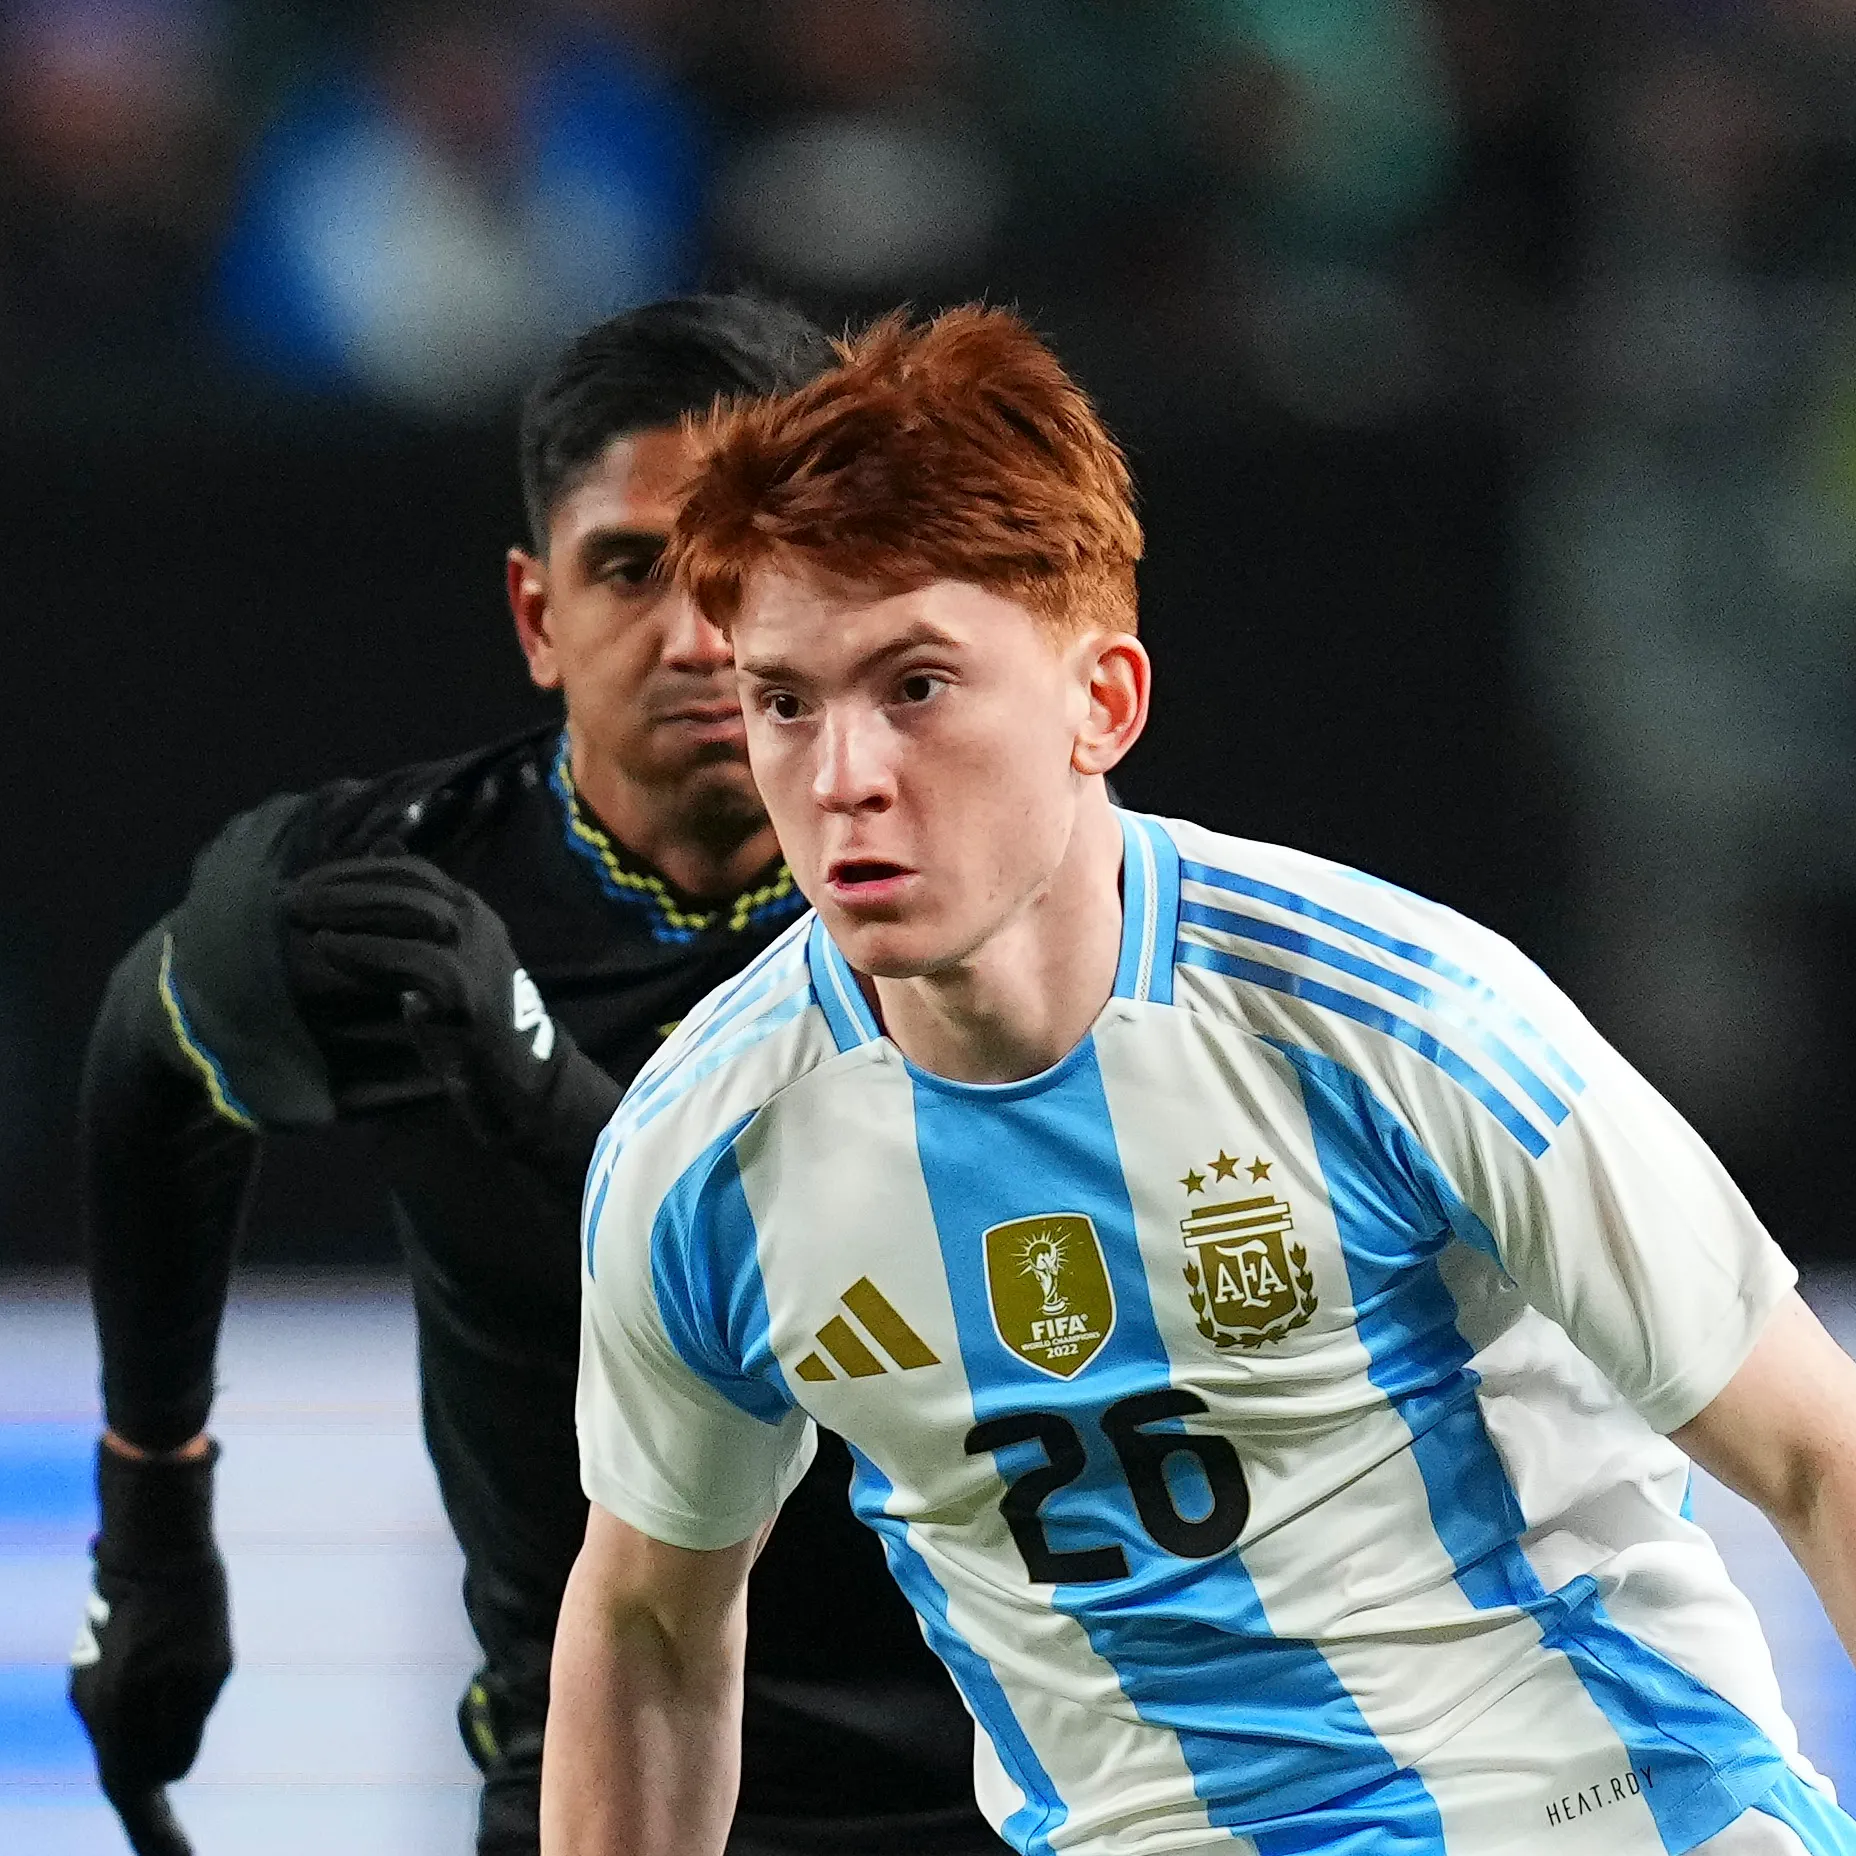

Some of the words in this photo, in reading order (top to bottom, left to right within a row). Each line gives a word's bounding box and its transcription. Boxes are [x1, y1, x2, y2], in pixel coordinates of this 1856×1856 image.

[1214, 1239, 1288, 1308] AFA
[1031, 1314, 1087, 1341] FIFA
[1046, 1343, 1079, 1359] 2022
[964, 1390, 1251, 1585] 26
[1546, 1765, 1654, 1827] HEAT.RDY
